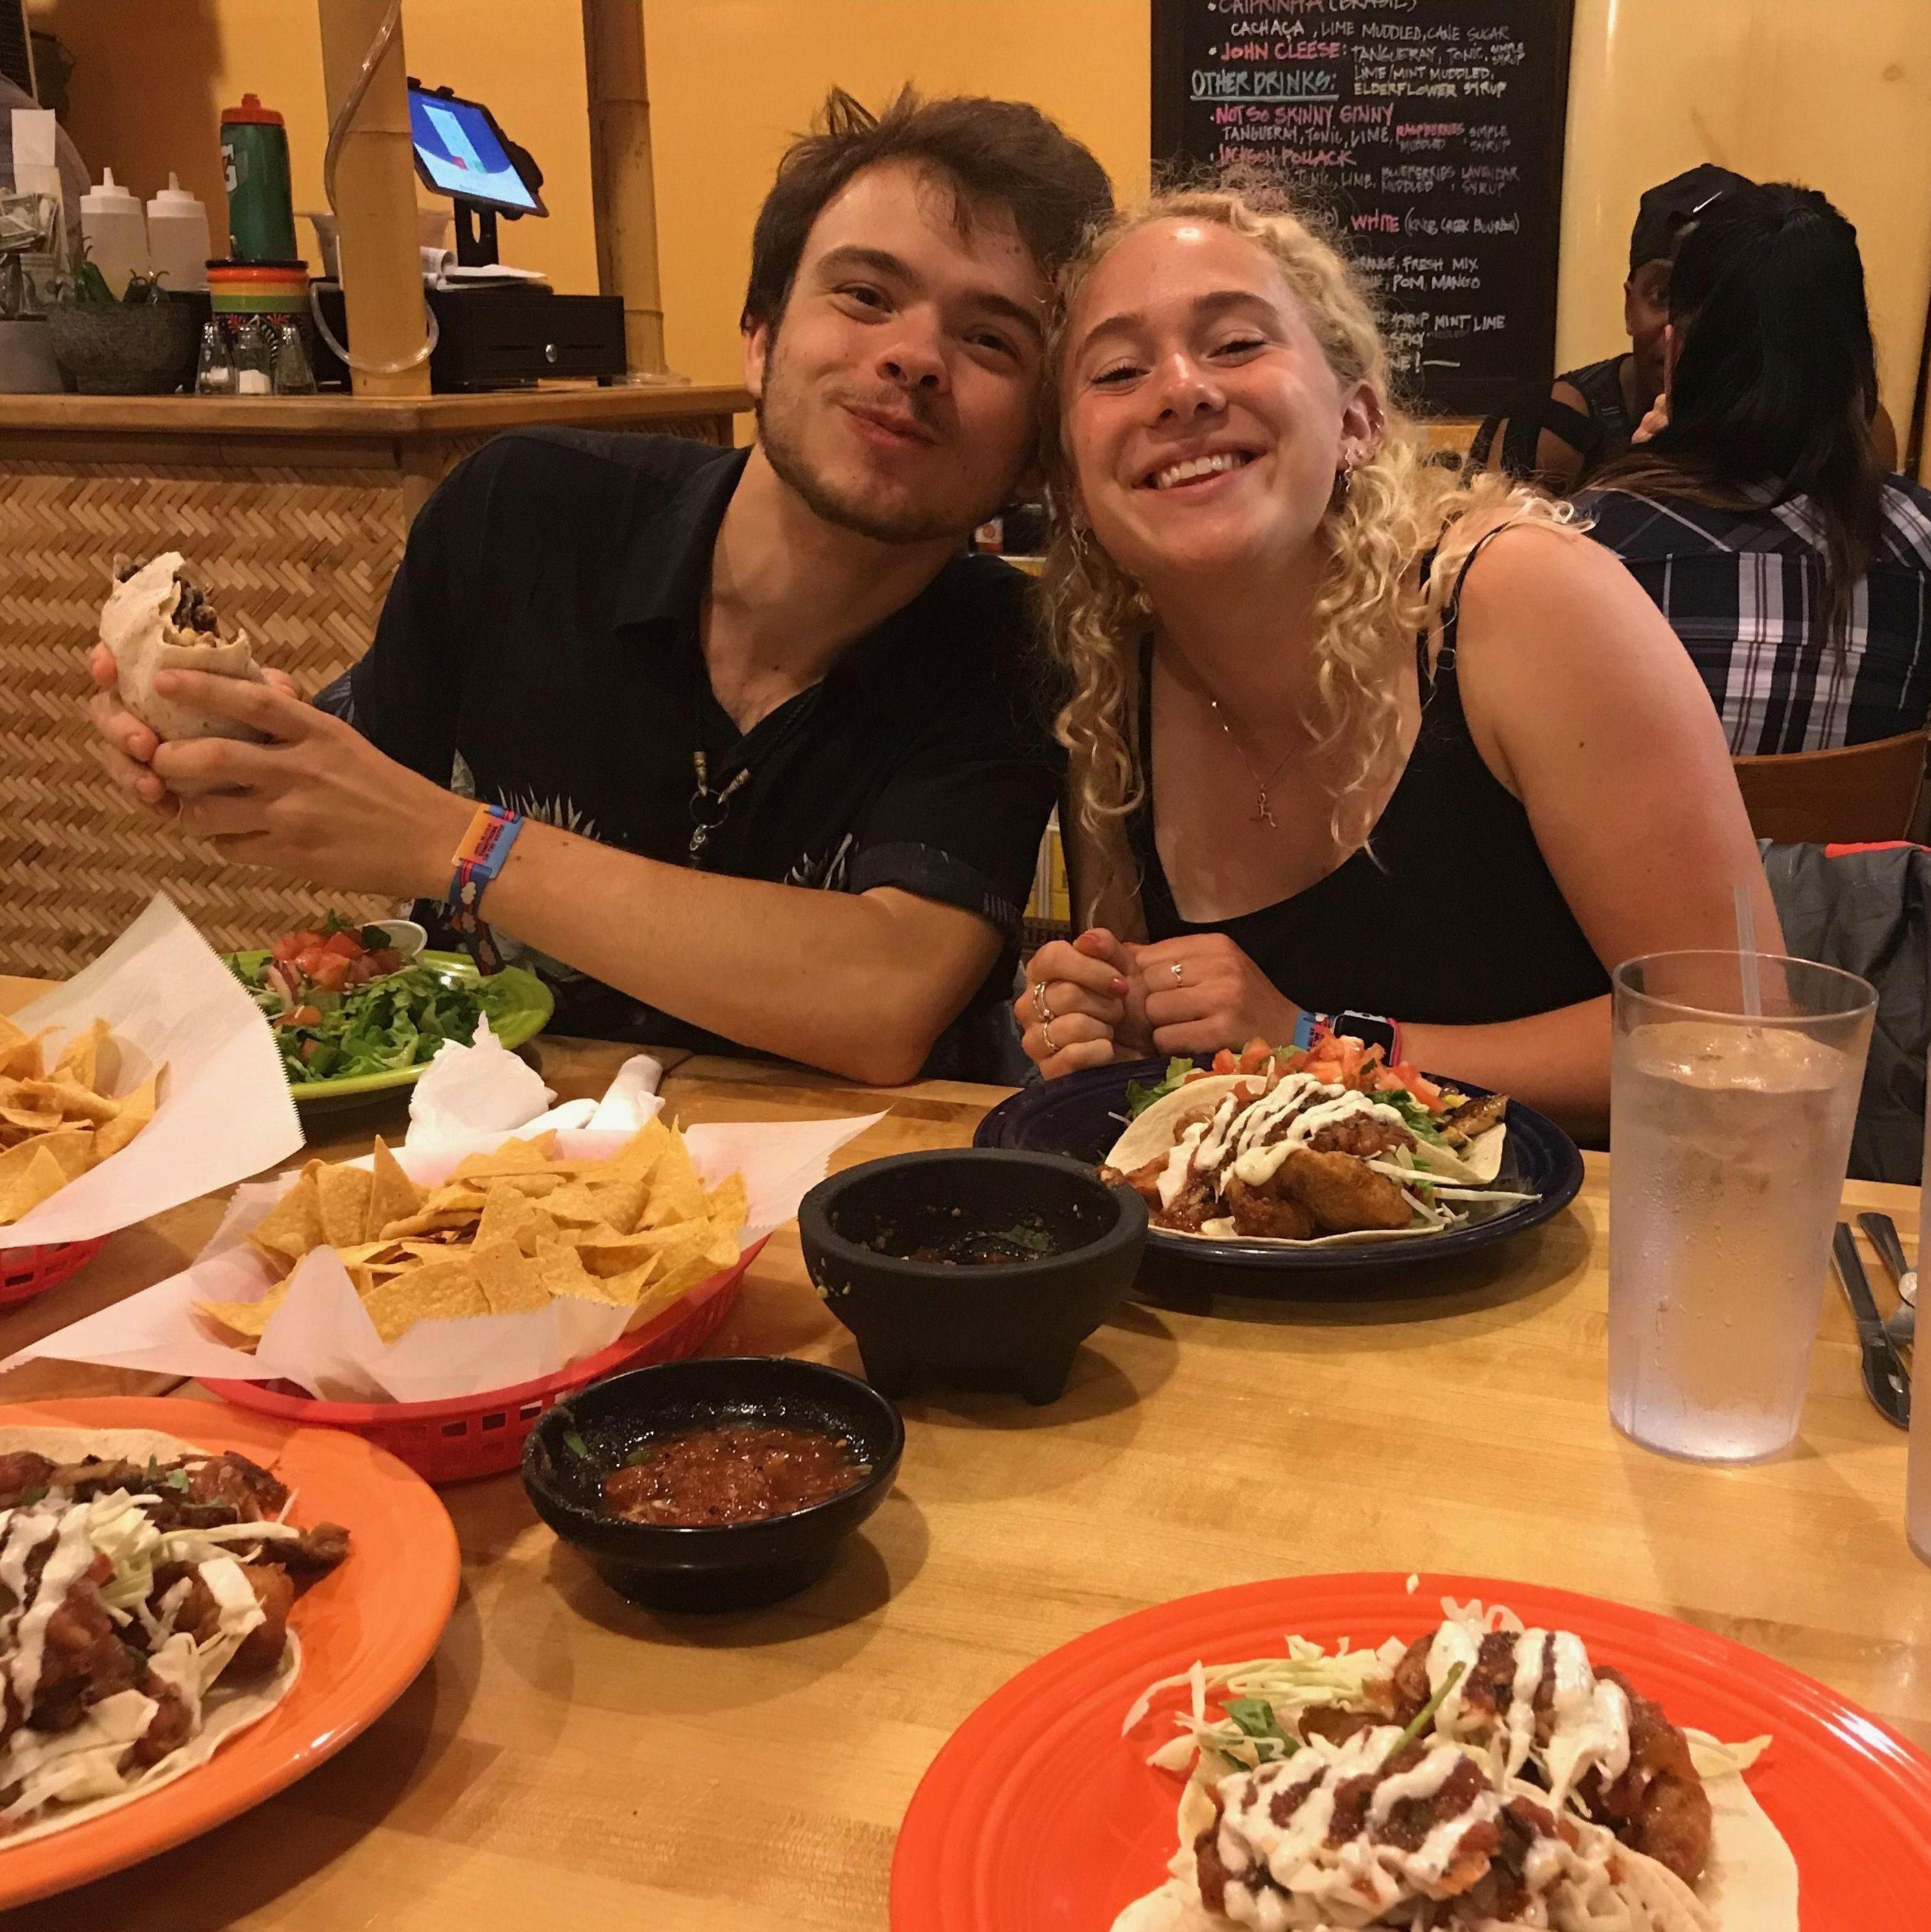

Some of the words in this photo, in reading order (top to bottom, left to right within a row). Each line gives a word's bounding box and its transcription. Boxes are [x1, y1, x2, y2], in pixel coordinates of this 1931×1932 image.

[1321, 21, 1355, 36] LIME
[1427, 24, 1460, 41] CANE
[1466, 26, 1510, 41] SUGAR
[1220, 42, 1268, 61] JOHN
[1274, 40, 1347, 60] CLEESE:
[1351, 45, 1441, 65] TANGUERAY,
[1191, 69, 1251, 96] OTHER
[1254, 70, 1337, 96] DRINKS:
[1354, 82, 1458, 98] ELDERFLOWER
[1463, 80, 1508, 98] SYRUP
[1215, 104, 1245, 125] NOT
[1245, 105, 1269, 122] SO
[1274, 104, 1333, 132] SKINNY
[1339, 102, 1393, 126] GINNY
[1222, 124, 1304, 145] TANGUERAY,
[1281, 146, 1357, 169] POLLACK
[1462, 178, 1506, 198] SYRUP
[1351, 209, 1400, 233] WHITE
[1403, 255, 1444, 272] FRESH
[1452, 257, 1479, 272] MIX
[1431, 274, 1481, 291] MANGO
[1434, 314, 1472, 331] MINT
[1473, 314, 1506, 332] LIME
